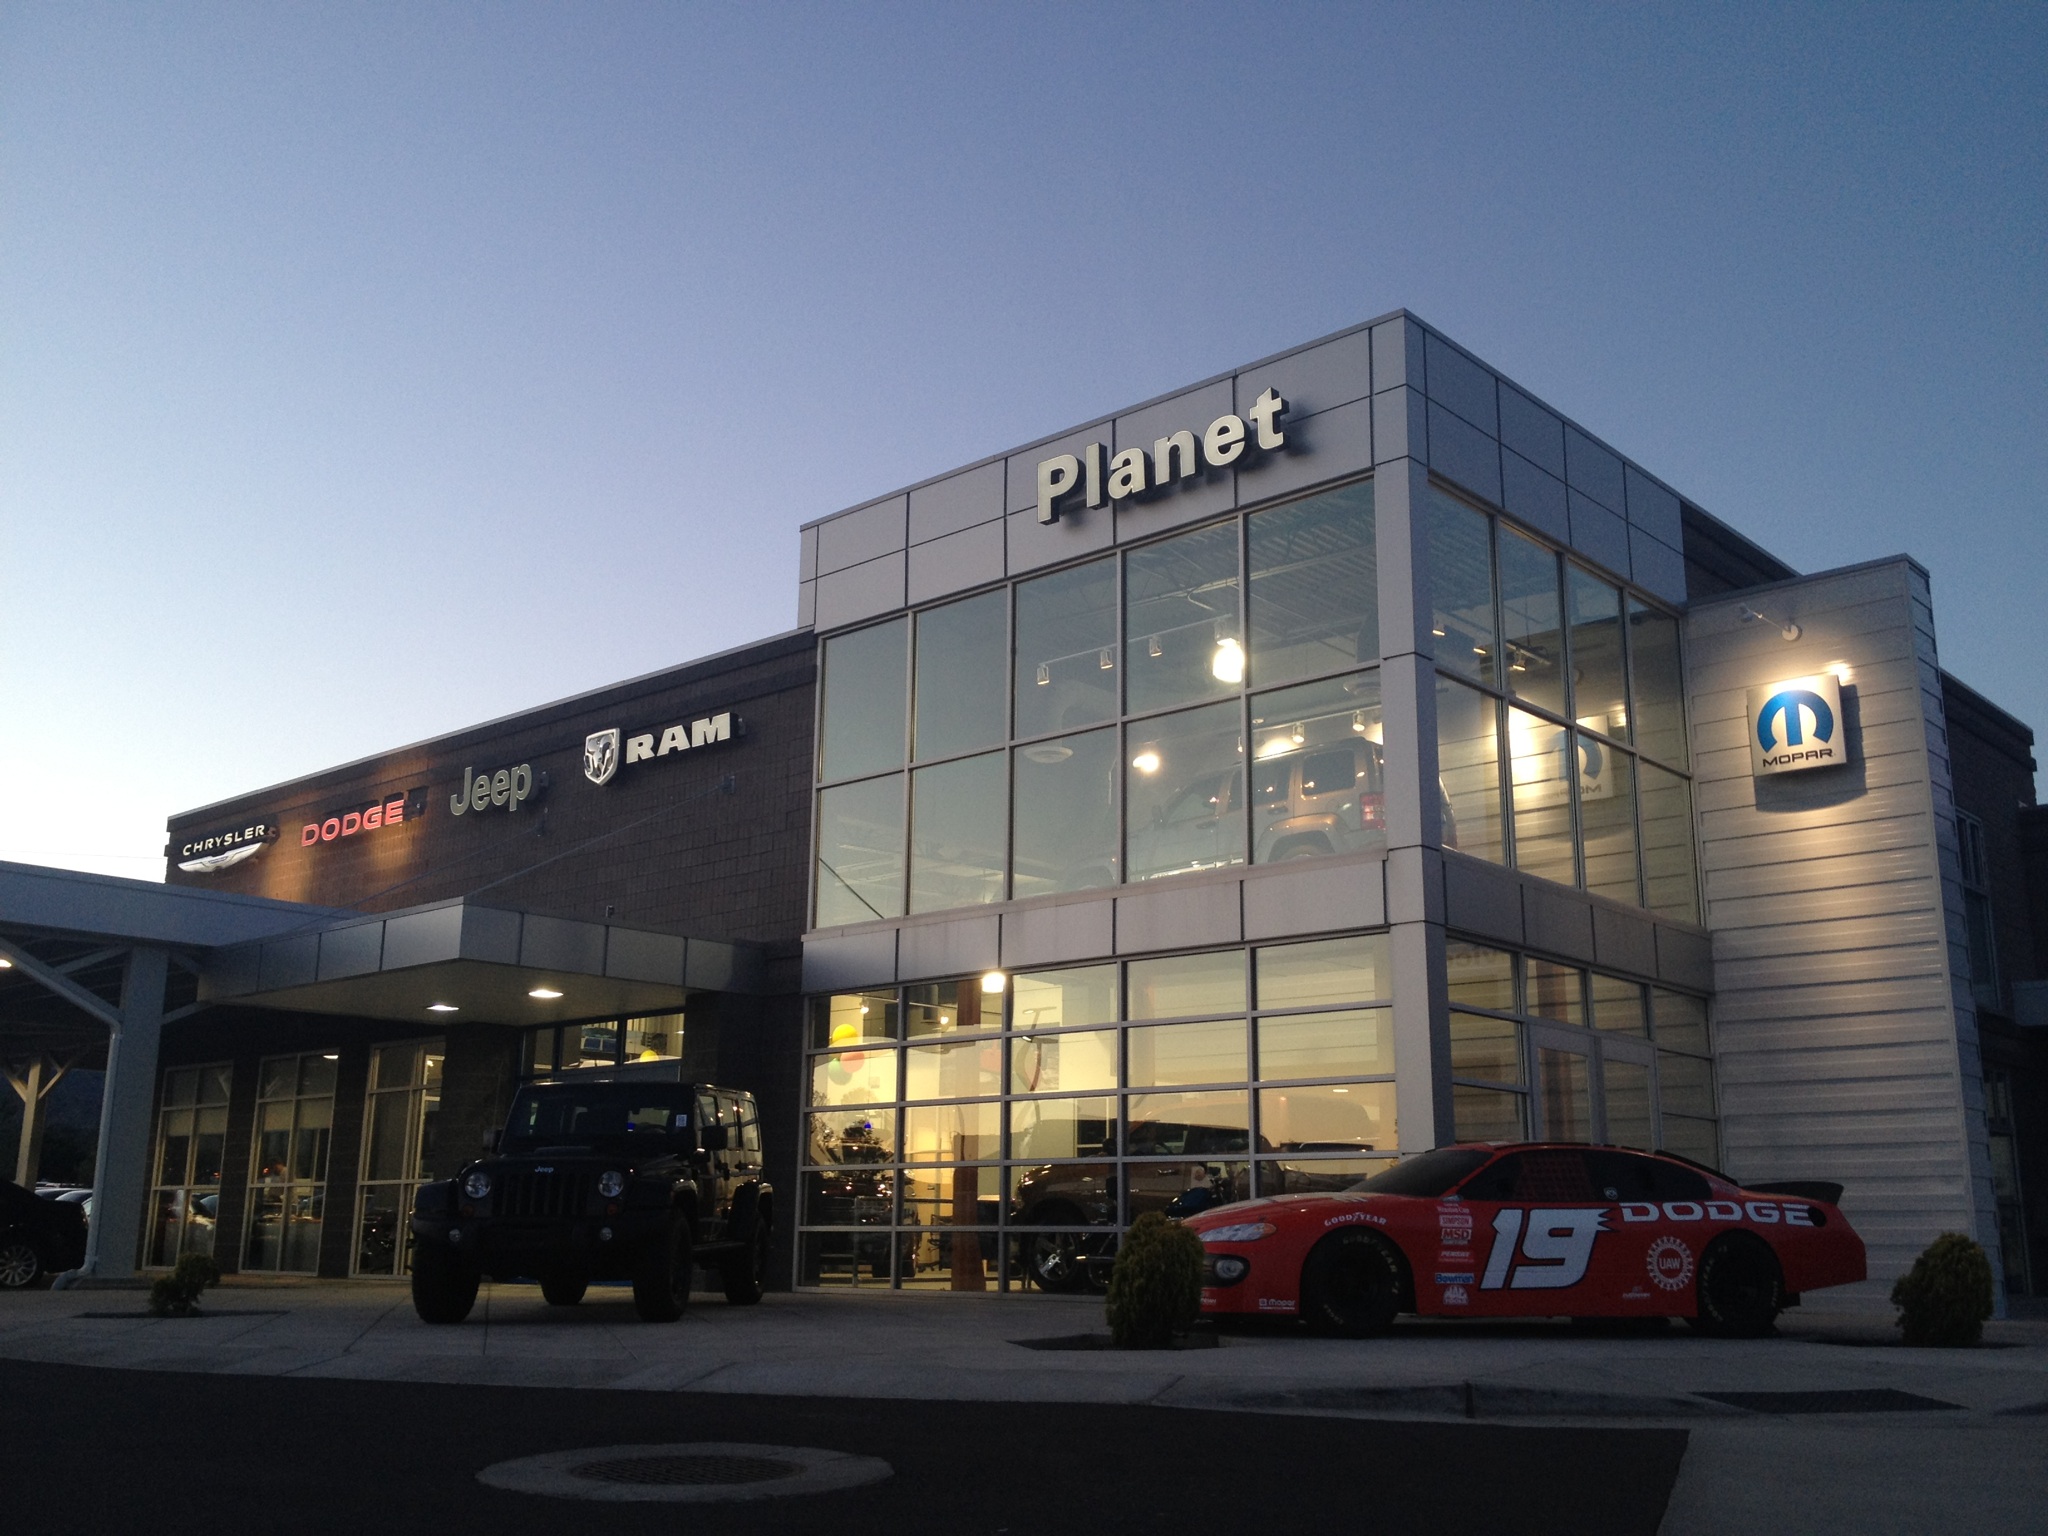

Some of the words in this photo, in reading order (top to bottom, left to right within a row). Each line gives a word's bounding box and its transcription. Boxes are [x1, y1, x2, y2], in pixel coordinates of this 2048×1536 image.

[1037, 387, 1286, 523] Planet
[626, 712, 731, 764] RAM
[1762, 747, 1834, 768] MOPAR
[450, 763, 532, 816] Jeep
[301, 799, 405, 847] DODGE
[182, 824, 265, 856] CHRYSLER
[534, 1165, 555, 1174] Jeep
[1618, 1200, 1815, 1227] DODGE
[1442, 1229, 1470, 1239] MSD
[1479, 1207, 1614, 1290] 19
[1659, 1257, 1681, 1270] UAW
